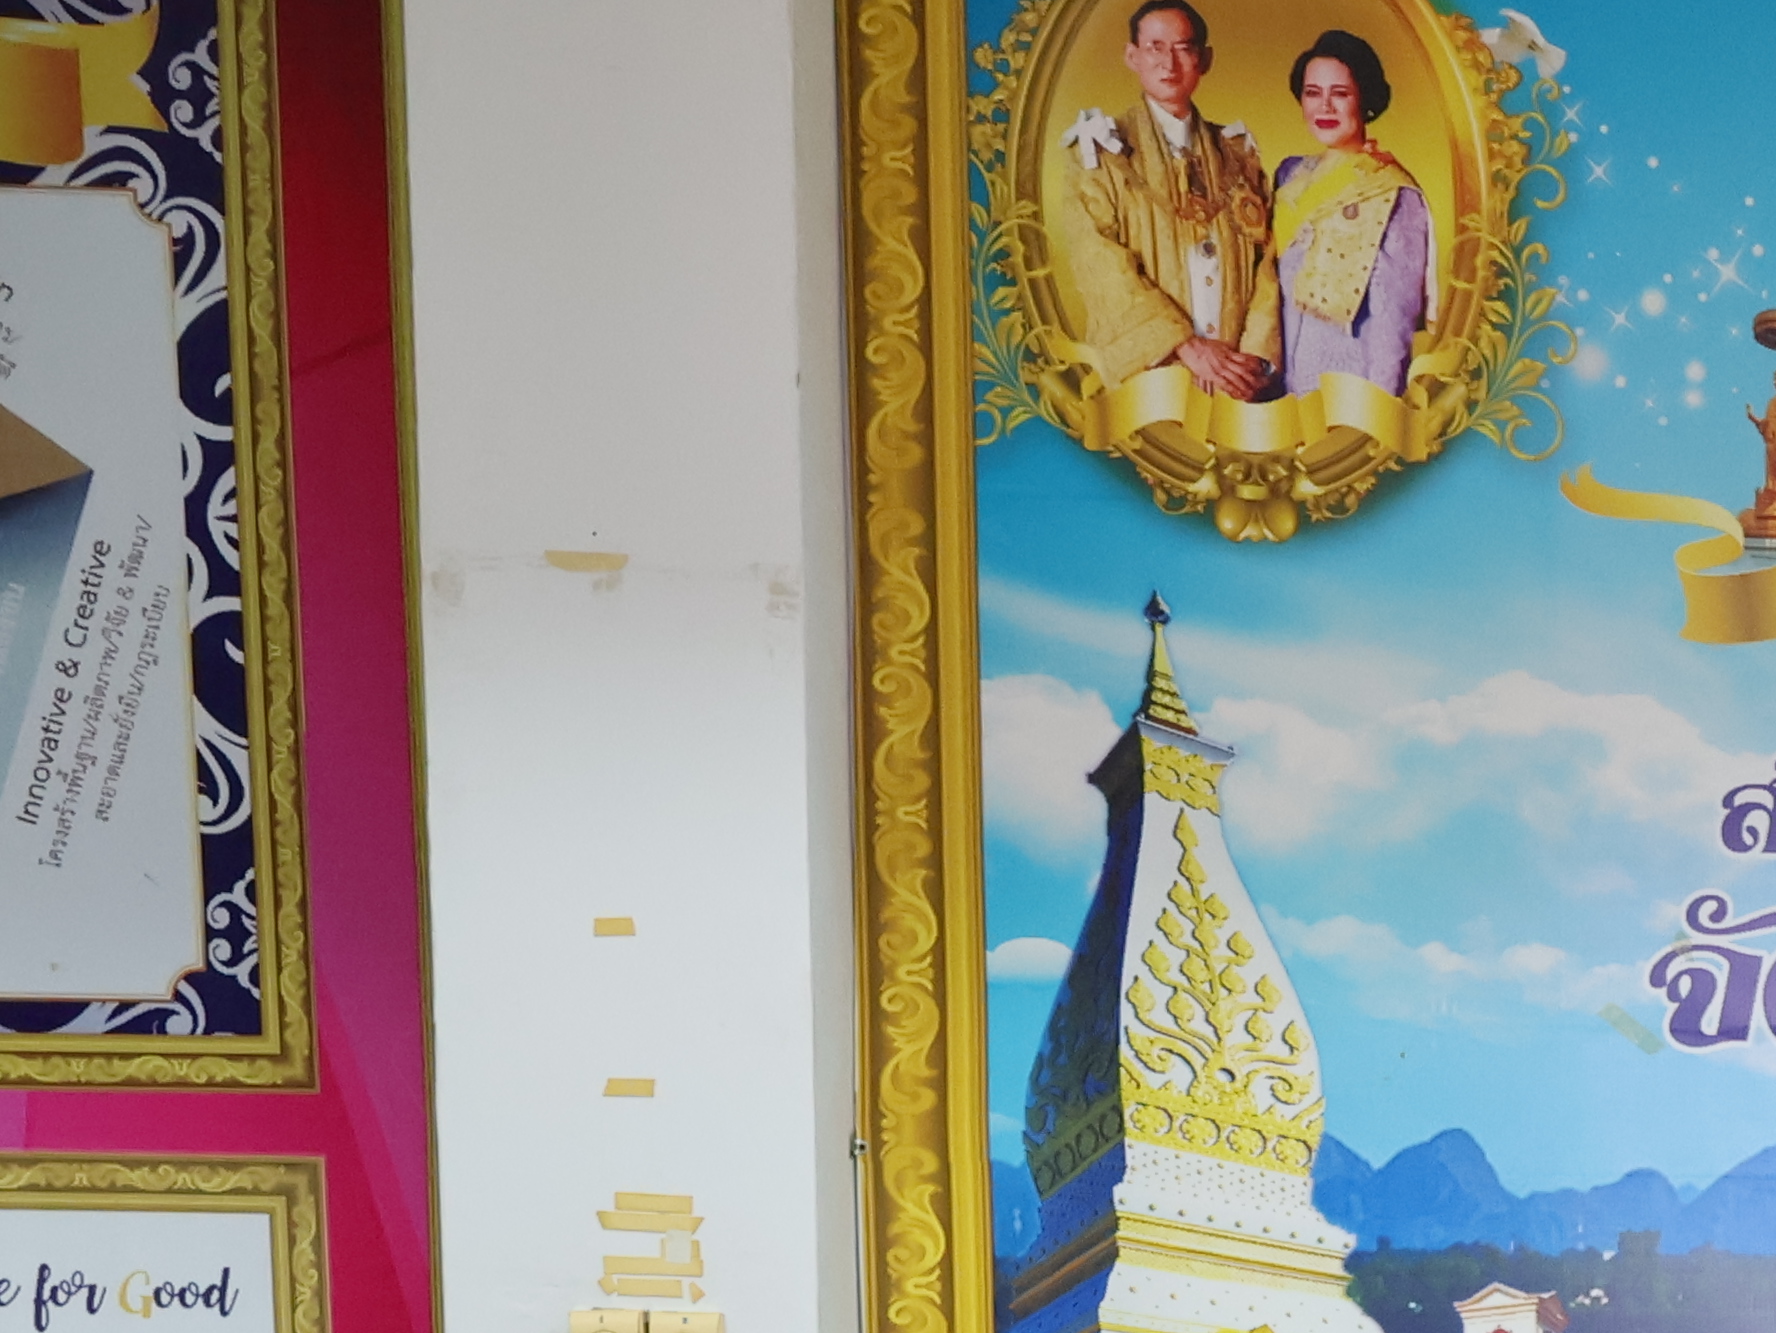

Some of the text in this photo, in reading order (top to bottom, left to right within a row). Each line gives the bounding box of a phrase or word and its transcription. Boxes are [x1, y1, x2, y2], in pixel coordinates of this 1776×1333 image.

[15, 539, 112, 826] Innovative & Creative
[34, 1263, 106, 1332] for
[118, 1267, 239, 1333] Good
